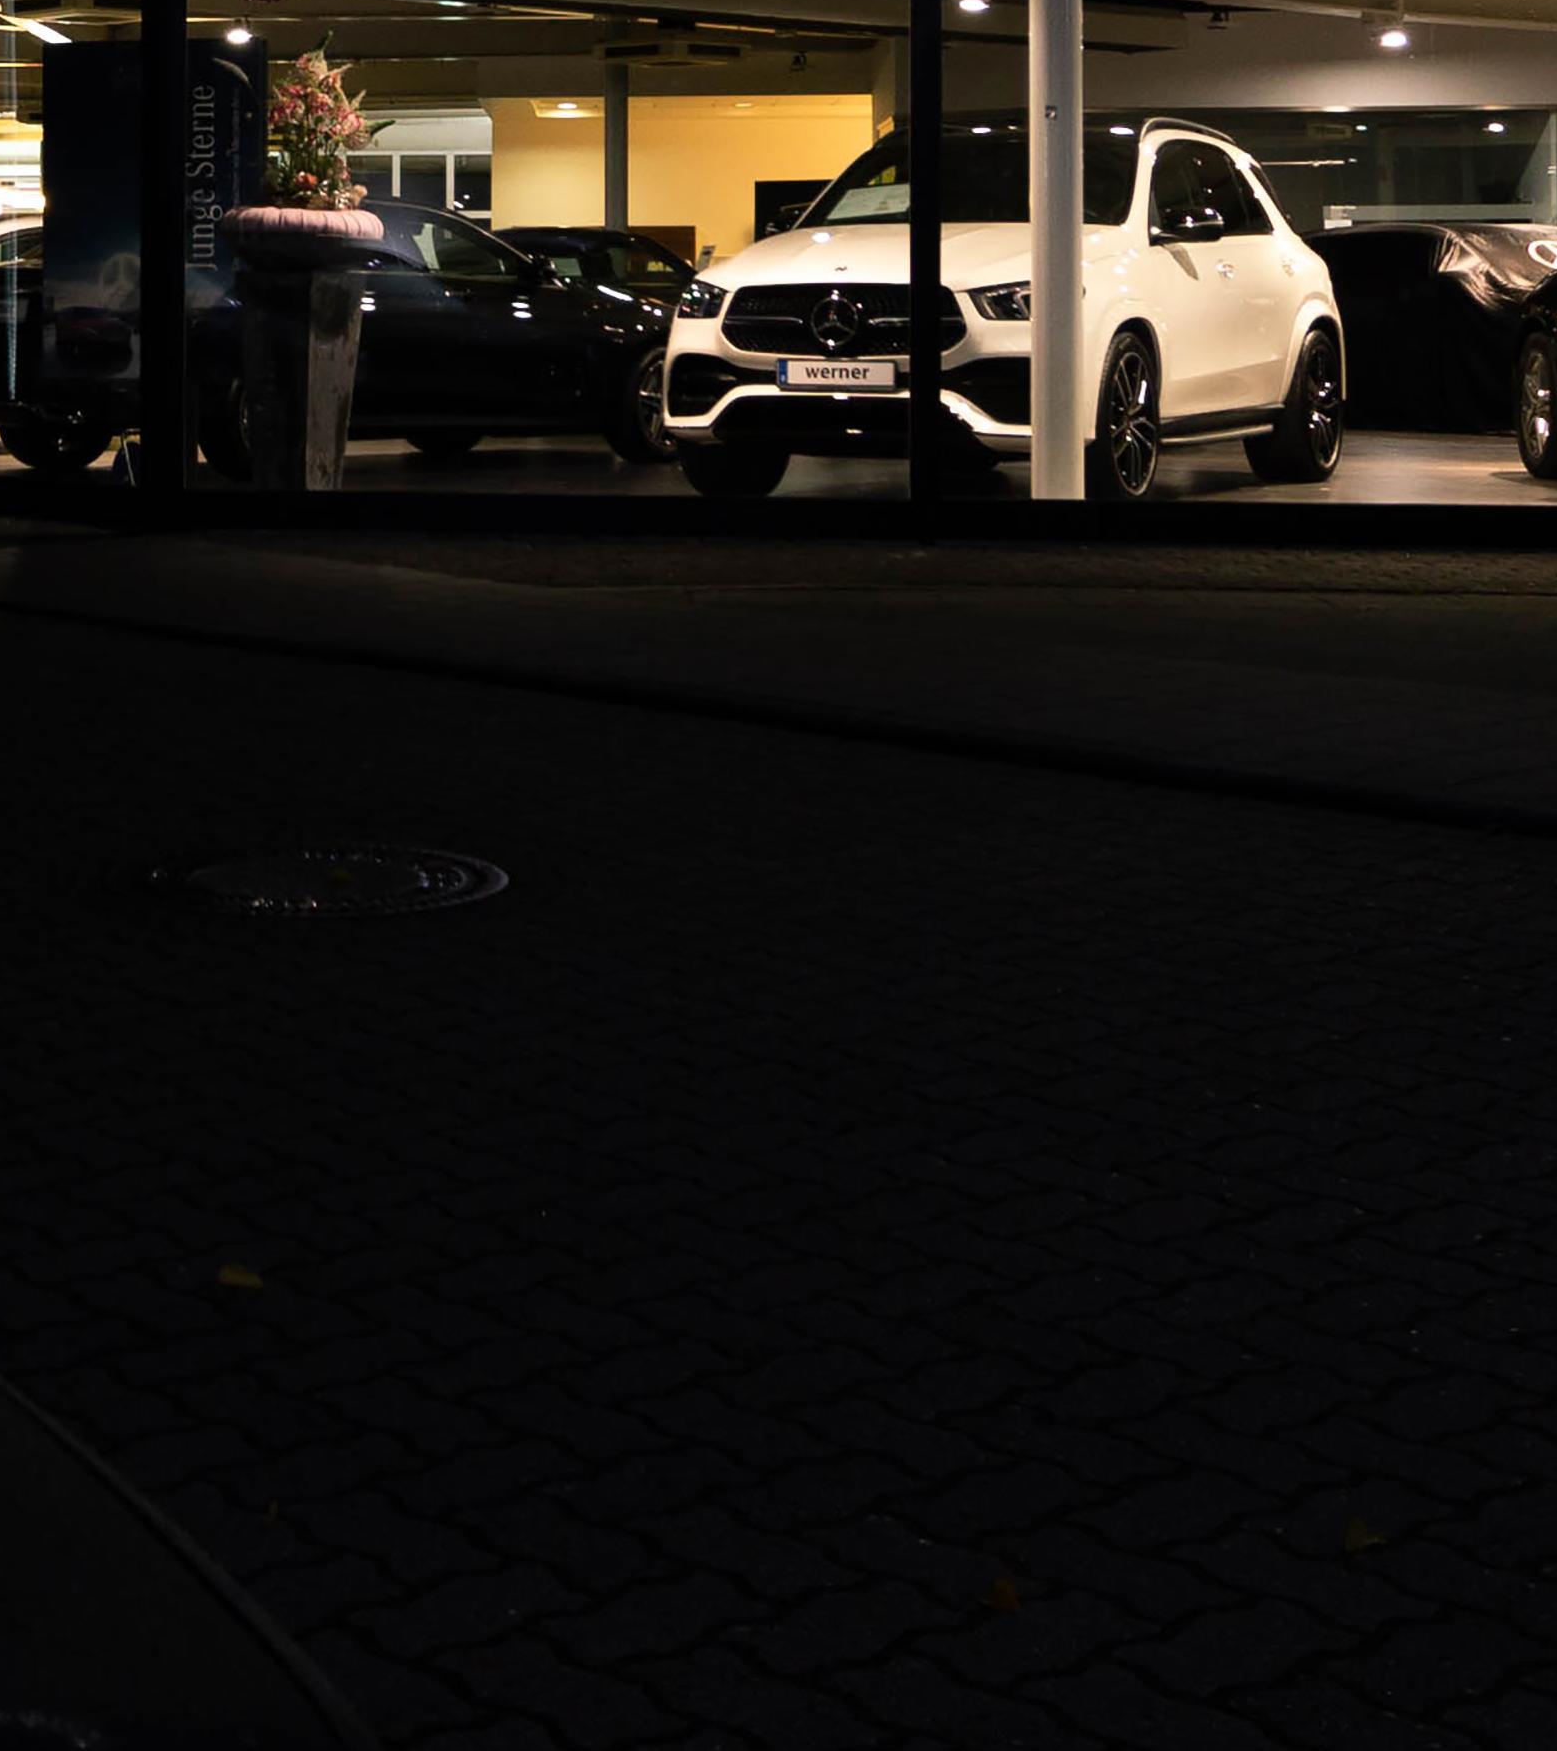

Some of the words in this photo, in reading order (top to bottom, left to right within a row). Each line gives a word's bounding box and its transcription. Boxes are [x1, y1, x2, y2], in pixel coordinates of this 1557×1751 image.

[186, 84, 216, 179] Sterne
[186, 188, 224, 271] Junge
[805, 367, 870, 380] werner
